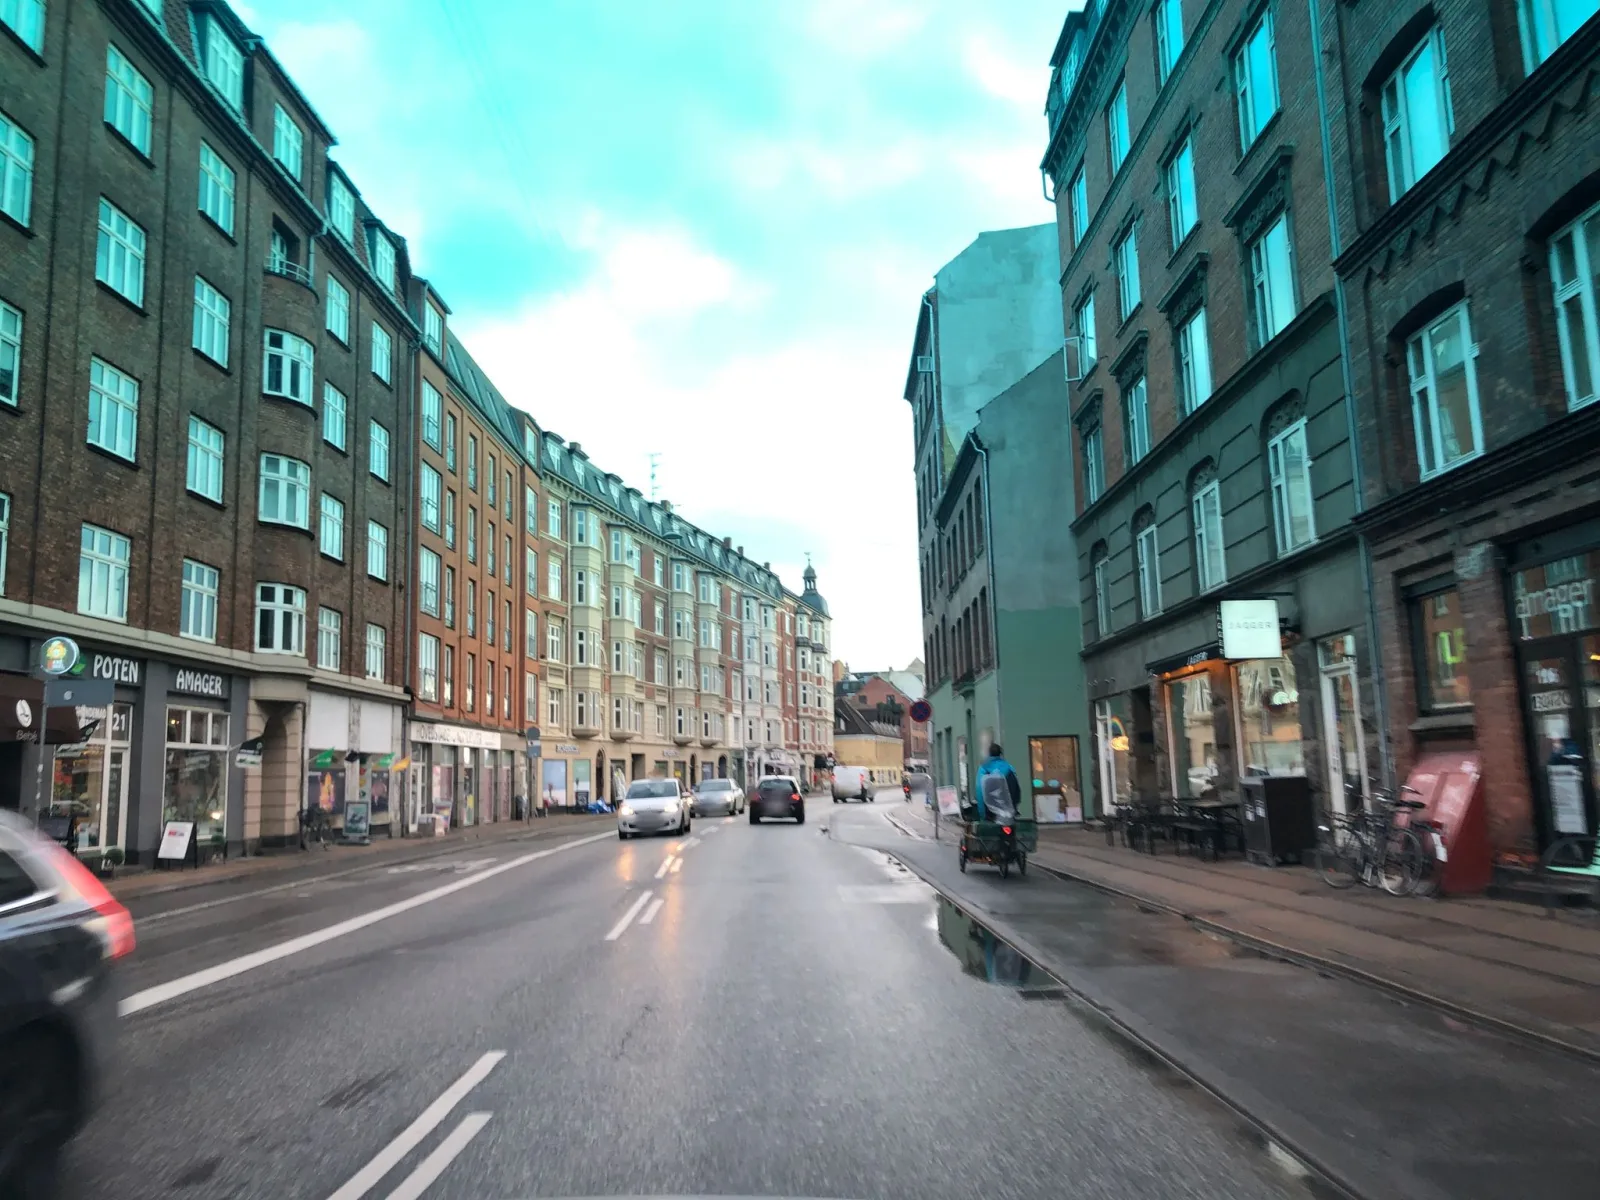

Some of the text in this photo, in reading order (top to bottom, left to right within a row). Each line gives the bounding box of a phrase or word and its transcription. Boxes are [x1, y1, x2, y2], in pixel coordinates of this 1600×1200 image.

[1228, 621, 1273, 630] JAGGER
[92, 654, 139, 683] POTEN
[175, 669, 222, 696] AMAGER
[112, 712, 126, 731] 21
